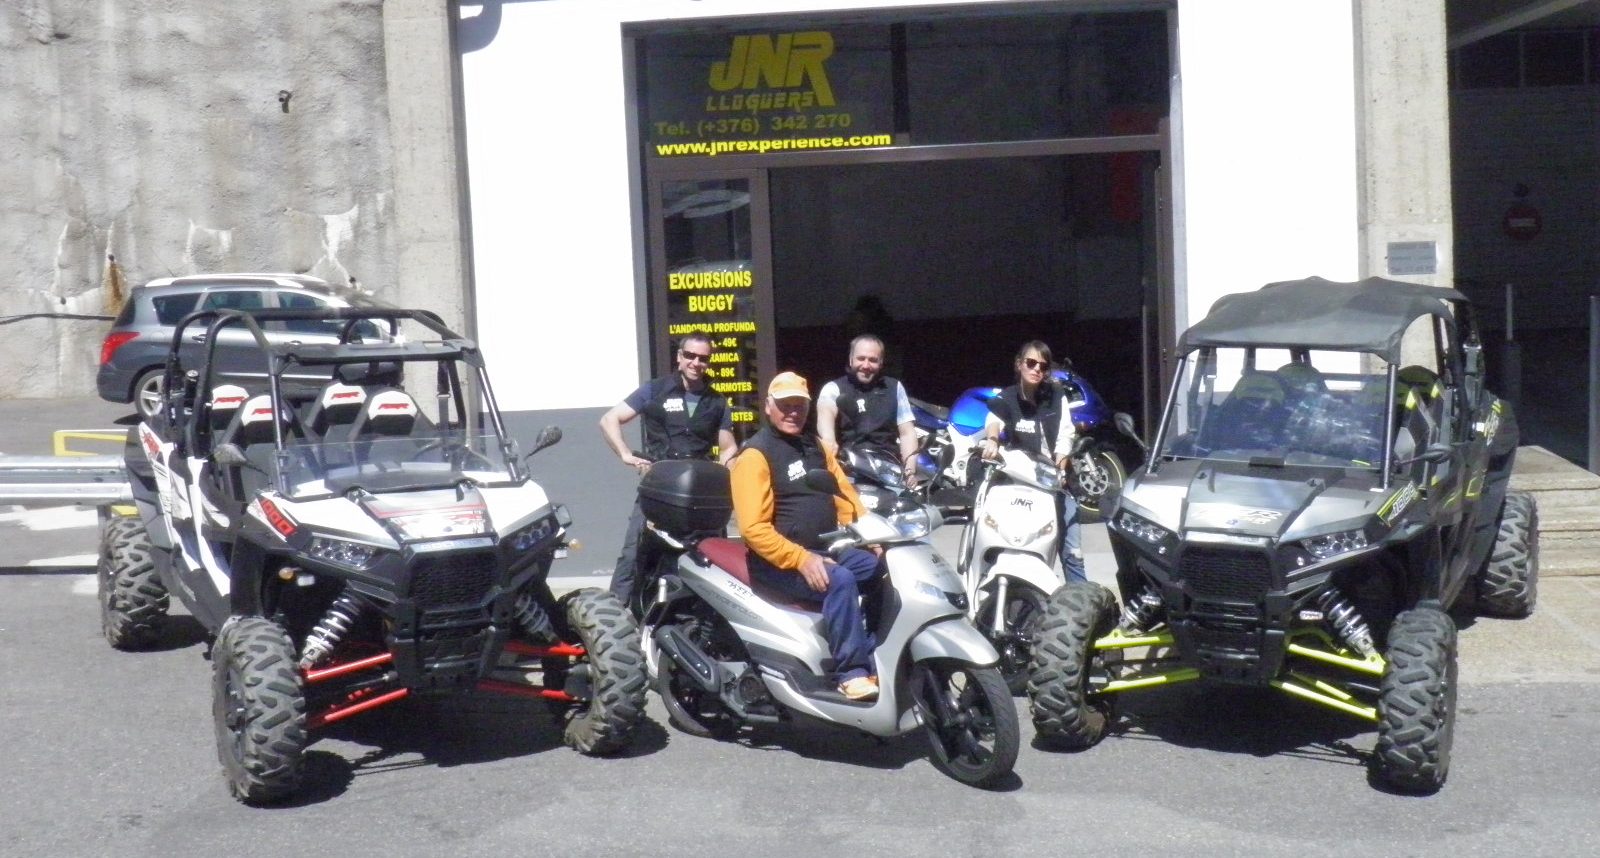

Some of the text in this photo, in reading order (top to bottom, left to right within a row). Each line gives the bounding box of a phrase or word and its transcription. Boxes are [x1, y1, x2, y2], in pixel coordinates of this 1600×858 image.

[709, 31, 835, 106] JNR
[655, 113, 851, 138] Tel. (+376) 342 270
[657, 134, 890, 155] www.jnrexperience.com
[669, 270, 752, 290] EXCURSIONS
[688, 294, 735, 312] BUGGY
[713, 321, 756, 333] PROFUNDA
[730, 411, 754, 422] ISTES
[1010, 497, 1034, 512] JNR
